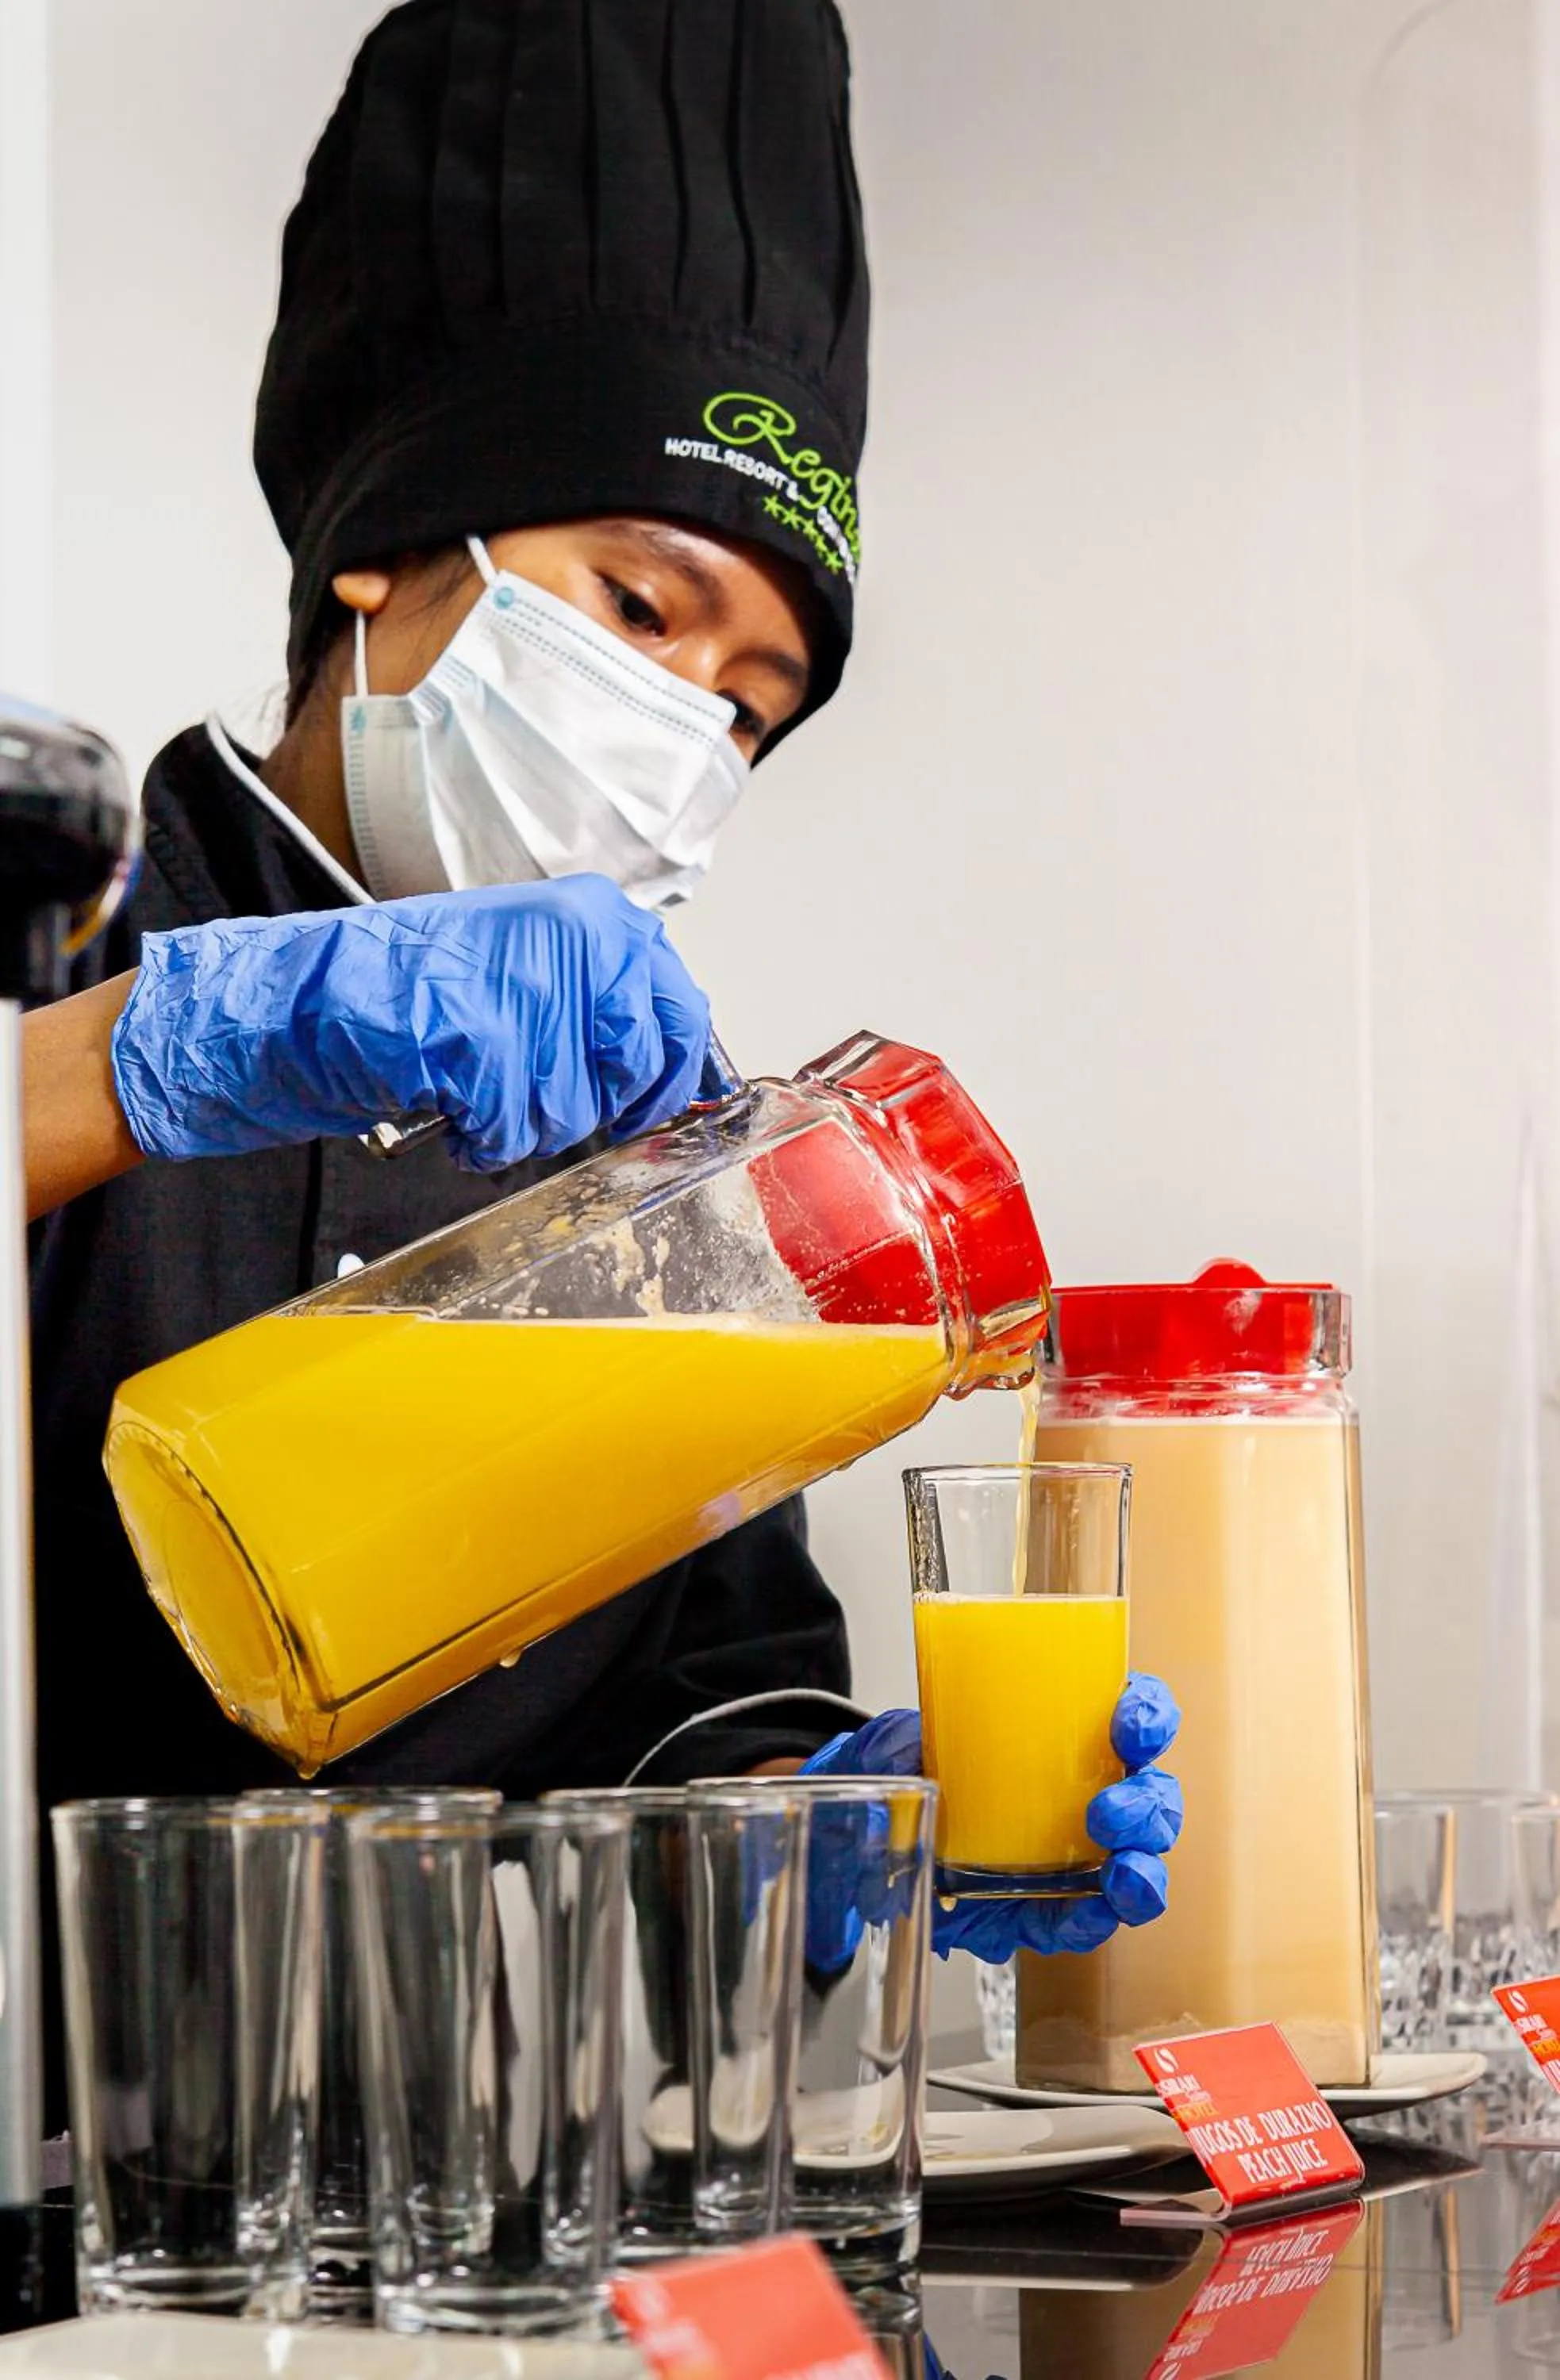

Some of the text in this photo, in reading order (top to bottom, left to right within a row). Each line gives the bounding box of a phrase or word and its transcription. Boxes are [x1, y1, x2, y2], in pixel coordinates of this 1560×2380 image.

[664, 437, 721, 463] HOTEL
[723, 448, 790, 490] RESORT
[1233, 2115, 1264, 2146] DE
[1256, 2101, 1332, 2141] DURAZNO
[1236, 2138, 1329, 2186] PEACH JUICE
